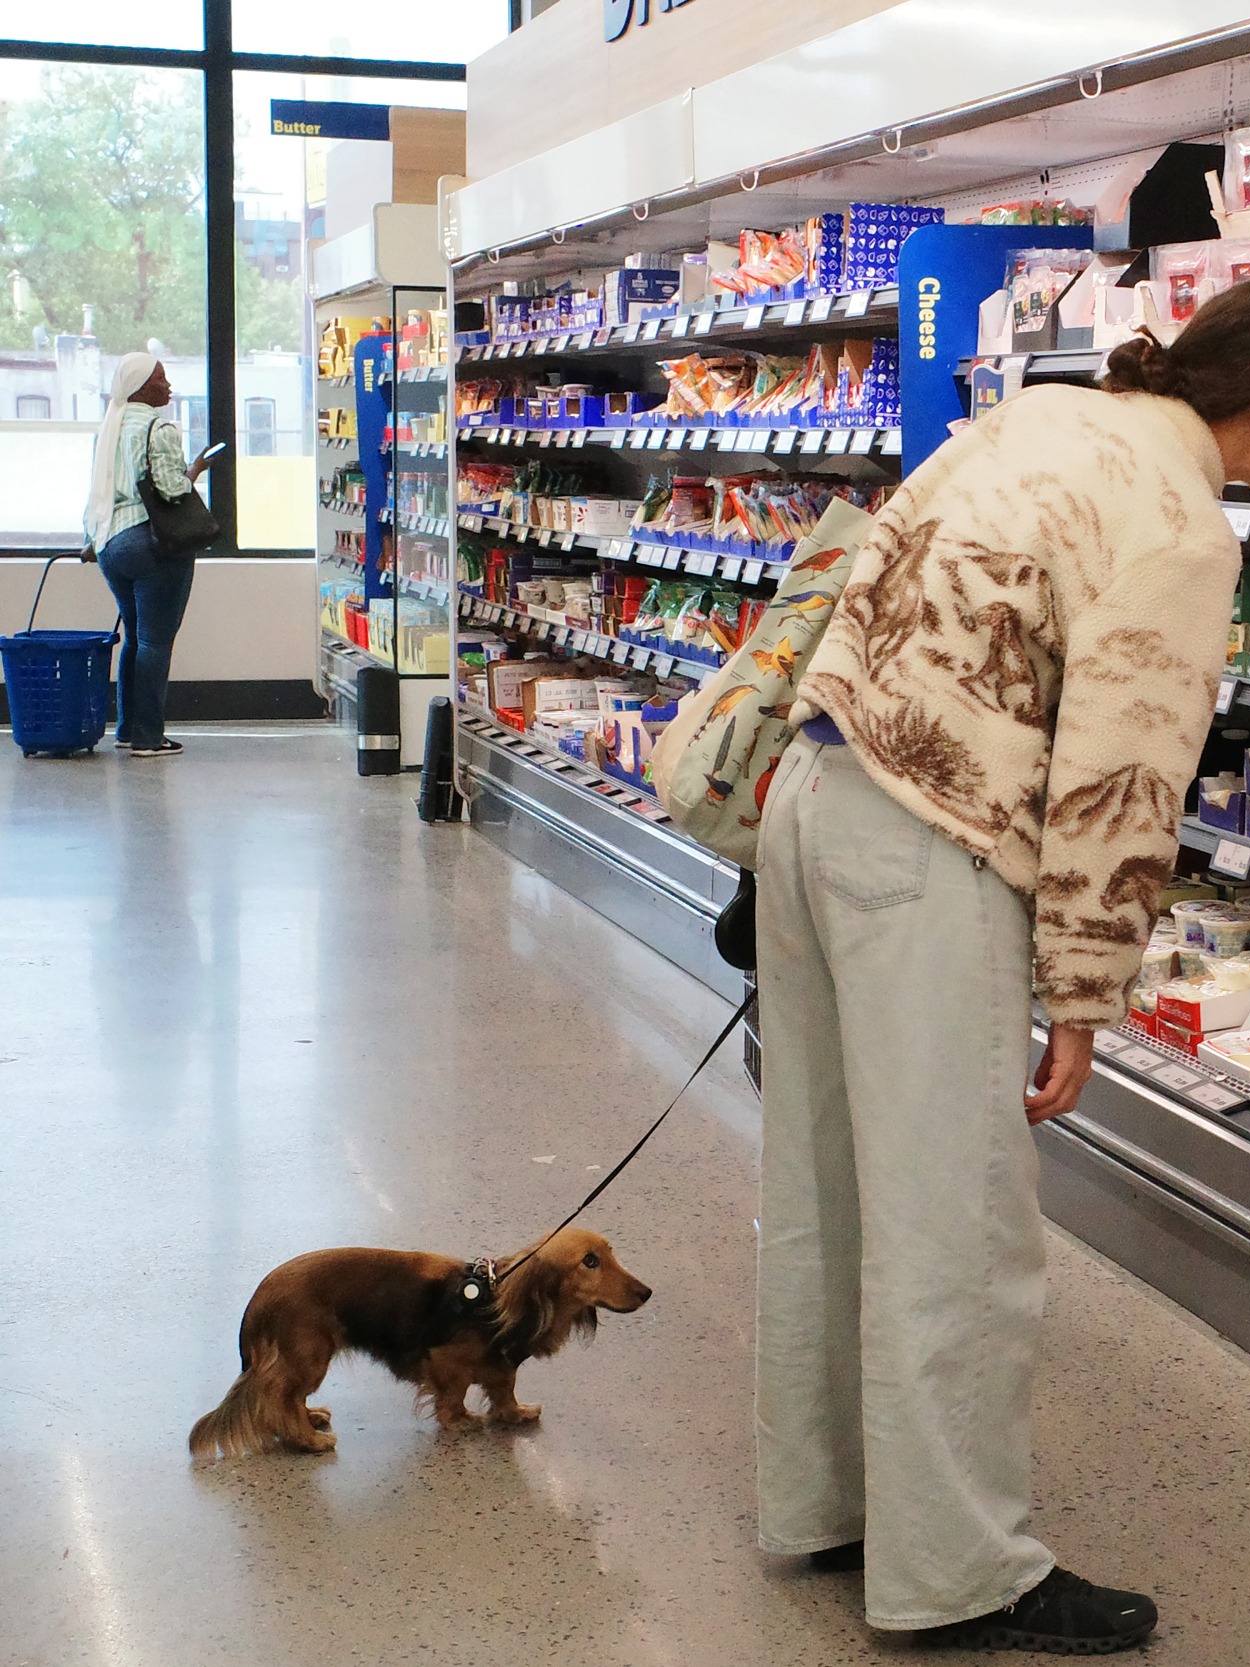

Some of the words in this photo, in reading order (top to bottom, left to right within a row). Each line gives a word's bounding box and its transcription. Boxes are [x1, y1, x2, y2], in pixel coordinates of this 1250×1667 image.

[273, 119, 321, 135] Butter
[918, 276, 941, 359] Cheese
[363, 358, 374, 392] Butter
